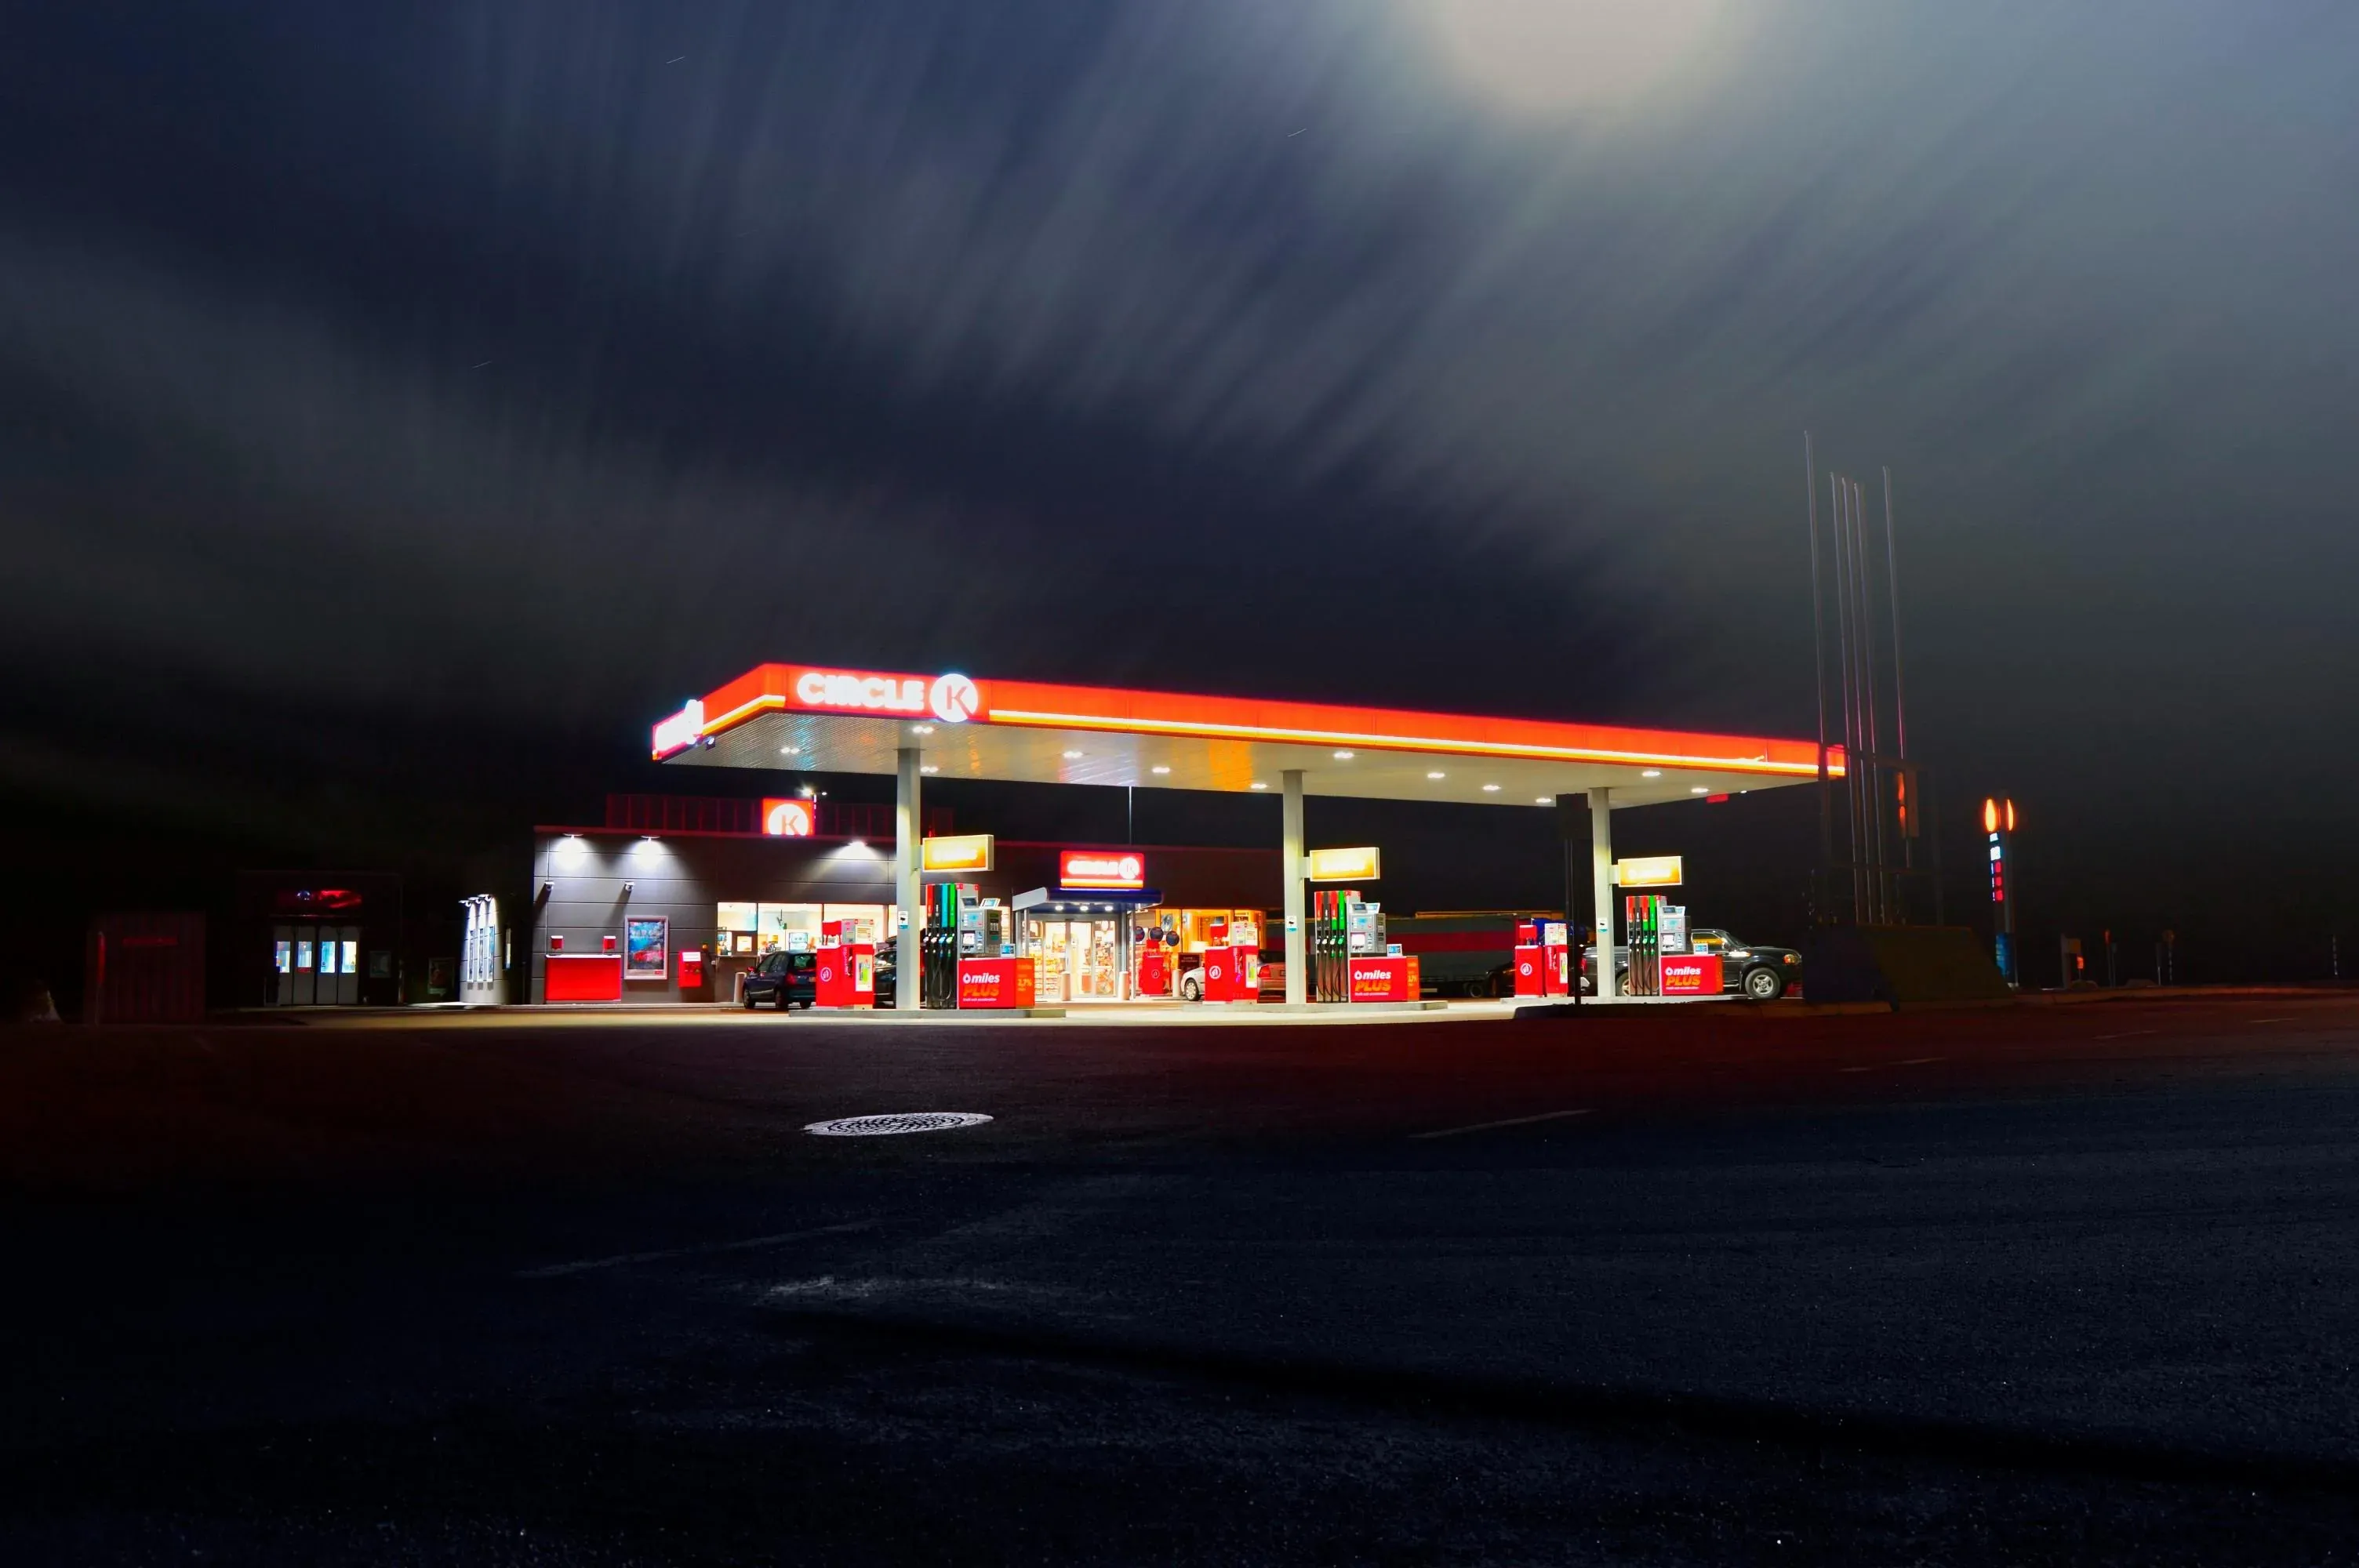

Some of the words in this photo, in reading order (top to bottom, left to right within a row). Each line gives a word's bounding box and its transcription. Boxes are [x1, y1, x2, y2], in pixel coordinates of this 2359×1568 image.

[797, 673, 925, 710] CIRCLE
[1362, 969, 1391, 980] miles
[1673, 966, 1701, 975] miles
[971, 972, 1000, 984] miles
[1666, 975, 1701, 986] PLUS
[962, 983, 1000, 997] PLUS
[1354, 979, 1391, 992] PLUS
